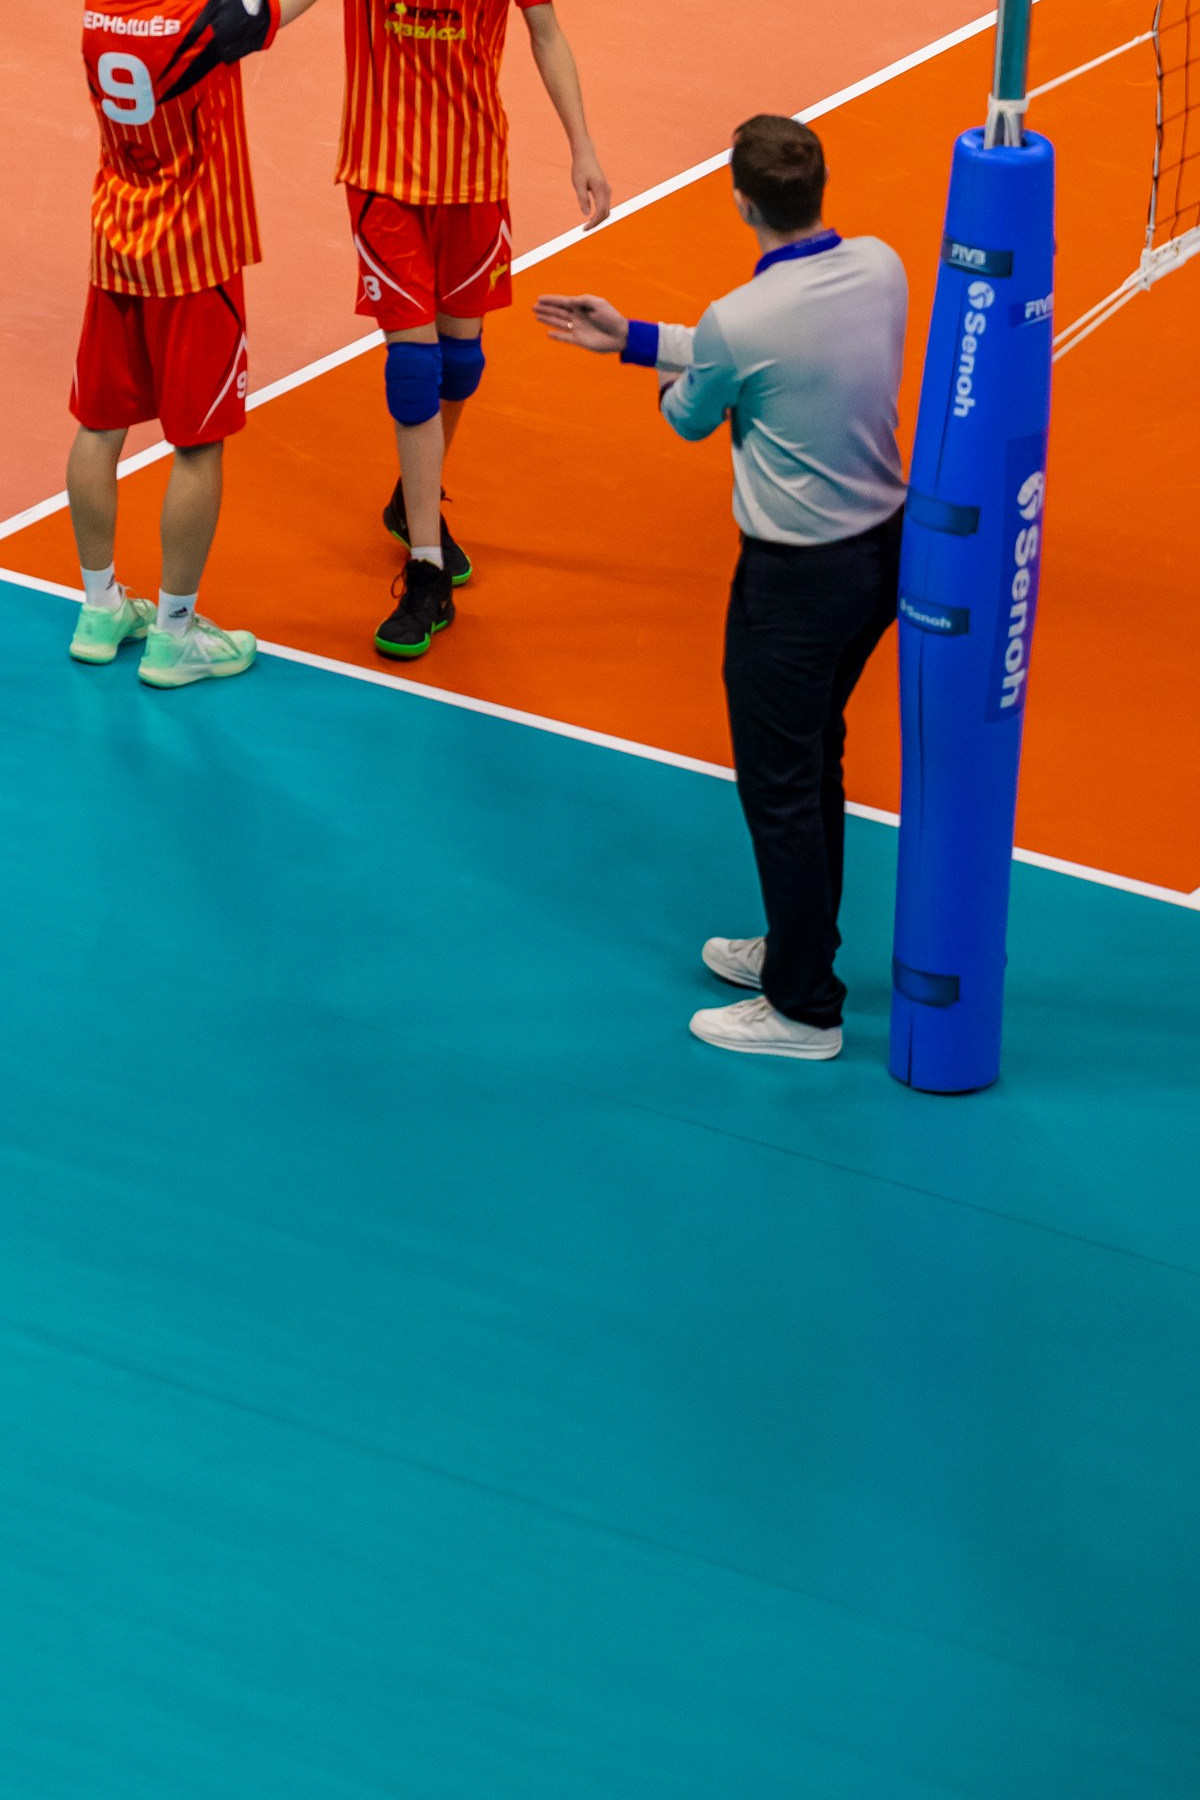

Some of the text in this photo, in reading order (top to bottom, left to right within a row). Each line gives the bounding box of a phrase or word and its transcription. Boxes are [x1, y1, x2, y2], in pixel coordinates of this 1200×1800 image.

[83, 10, 180, 38] ЕРНЫШЁВ
[97, 51, 156, 126] 9
[950, 242, 987, 266] FIVB
[953, 310, 987, 418] Senoh
[907, 605, 952, 630] Senoh
[999, 524, 1040, 709] Senoh
